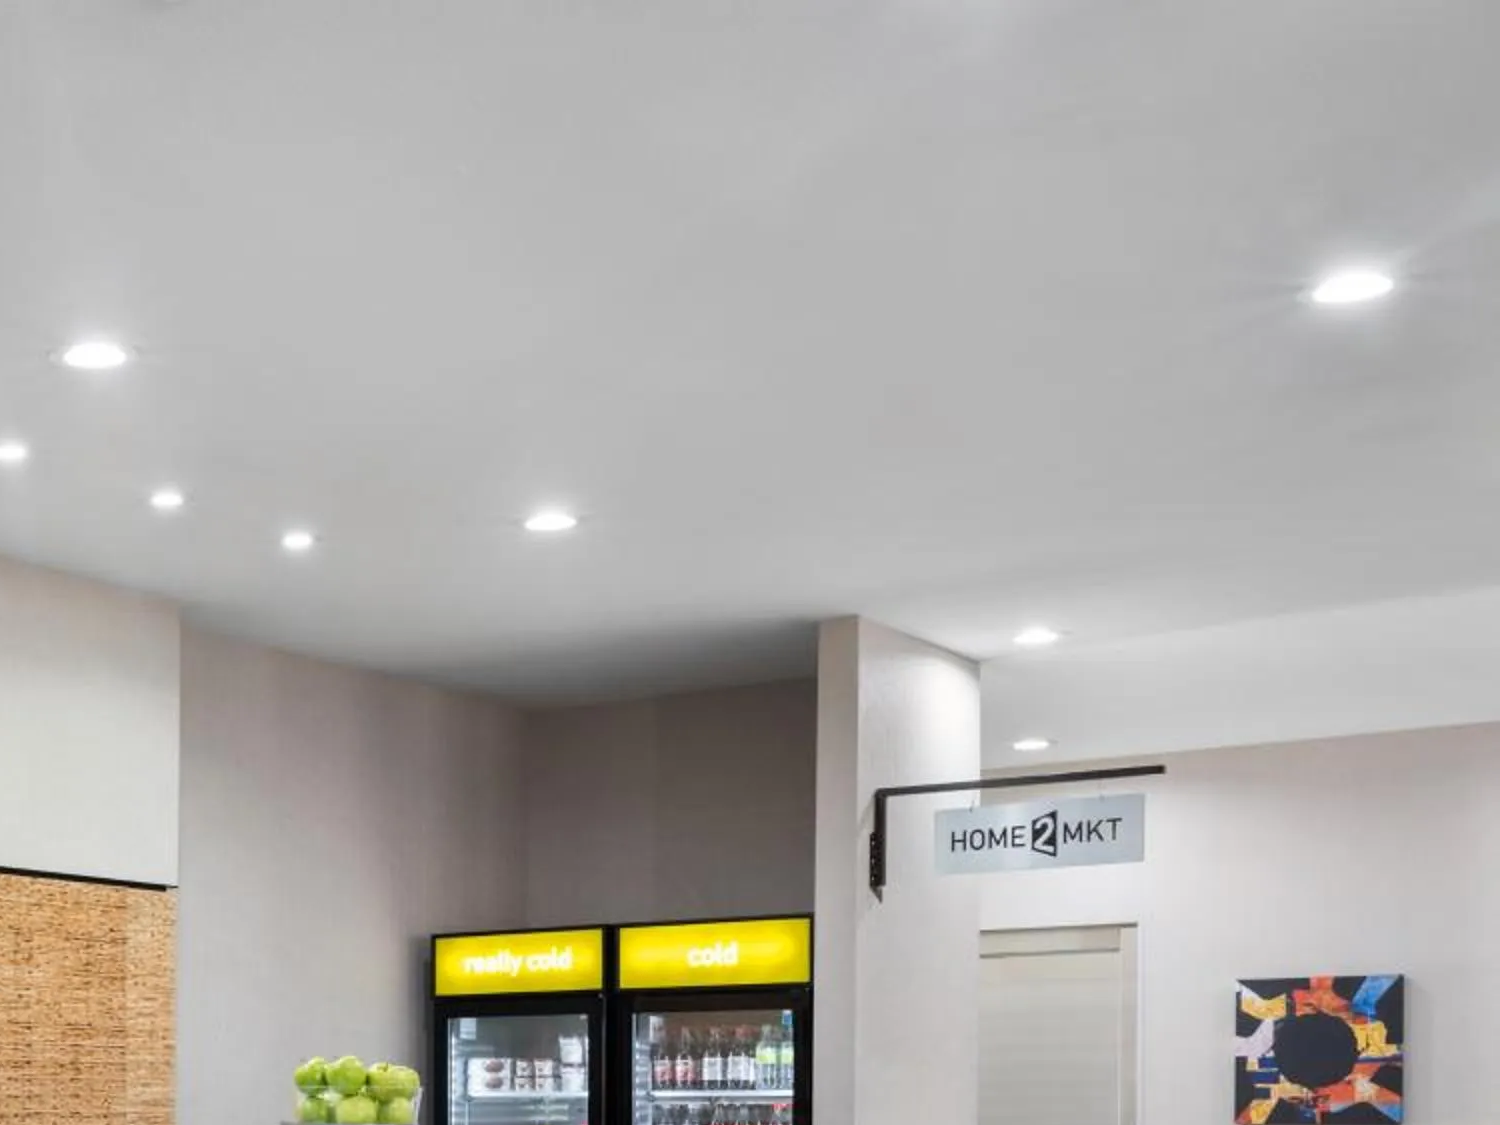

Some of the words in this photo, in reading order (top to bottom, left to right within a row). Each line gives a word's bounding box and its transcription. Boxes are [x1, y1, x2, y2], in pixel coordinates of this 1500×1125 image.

[464, 948, 522, 976] really
[526, 945, 573, 972] cold
[686, 941, 739, 968] cold
